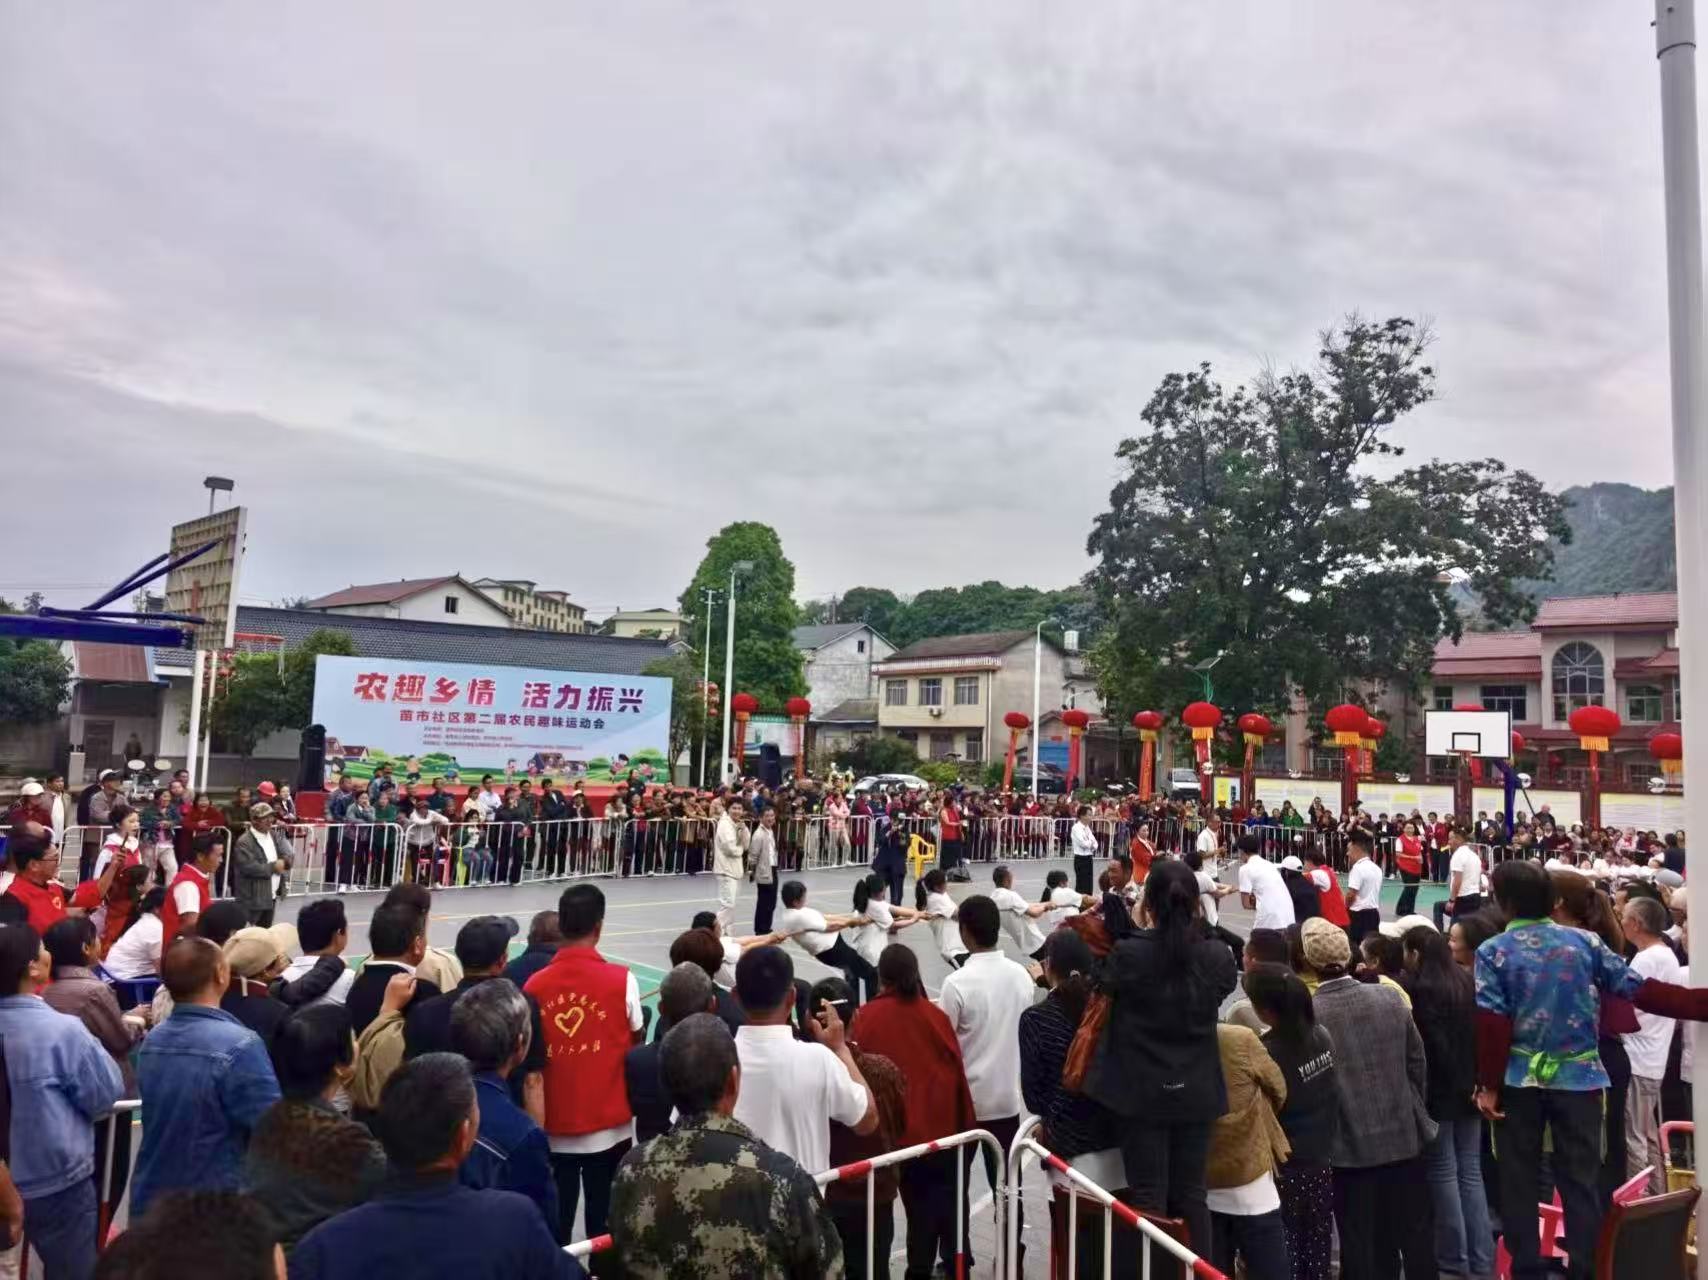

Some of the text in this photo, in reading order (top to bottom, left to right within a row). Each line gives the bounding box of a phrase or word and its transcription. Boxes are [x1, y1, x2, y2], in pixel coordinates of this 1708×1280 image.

[354, 672, 645, 713] 农趣乡情 活力振兴
[400, 709, 606, 730] 苗市社区第二届农民趣味运动会
